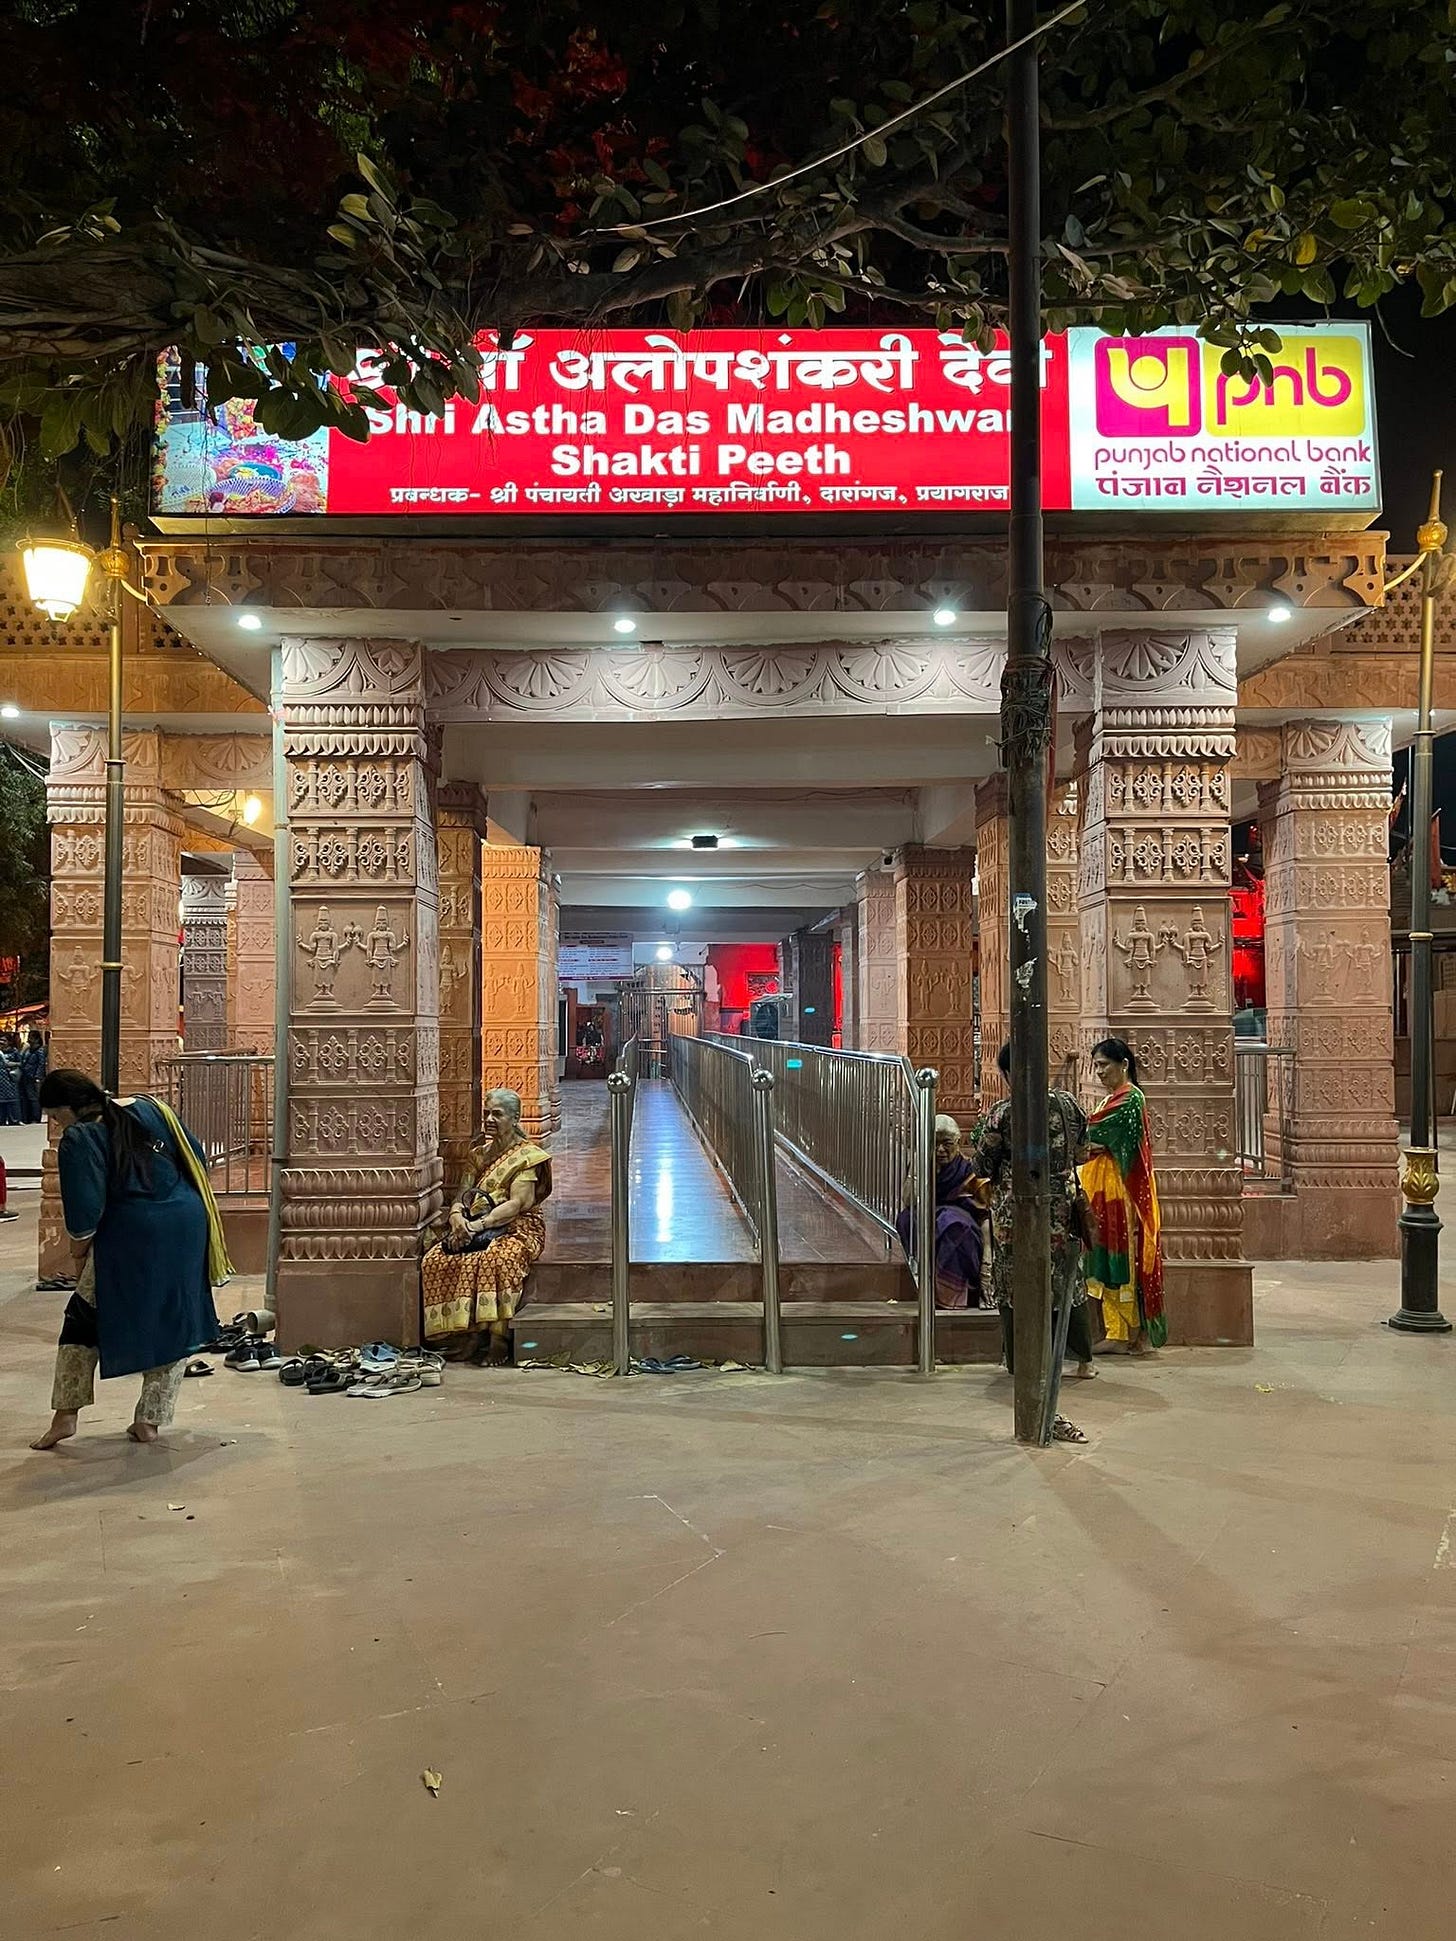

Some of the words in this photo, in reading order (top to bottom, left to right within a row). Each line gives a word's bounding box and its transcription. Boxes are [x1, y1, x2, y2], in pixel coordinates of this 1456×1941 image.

[549, 332, 919, 393] अलोपशंकरी
[1216, 347, 1352, 426] pnb
[365, 402, 455, 434] Shri
[471, 402, 607, 434] Astha
[624, 403, 710, 434] Das
[727, 402, 1011, 434] Madheshwa
[551, 444, 700, 475] Shakti
[717, 443, 851, 475] Peeth
[1095, 441, 1185, 470] punjab
[1192, 440, 1302, 463] national
[1307, 440, 1371, 463] bank
[489, 481, 518, 503] श्री
[524, 481, 601, 504] पंचायती
[608, 487, 685, 508] अखाड़ा
[691, 480, 811, 505] महानिर्वाणी,
[915, 485, 1010, 503] प्रयागराज
[1096, 470, 1186, 497] पंजाब
[1197, 465, 1305, 499] नैशनल
[1320, 466, 1371, 496] बैंक
